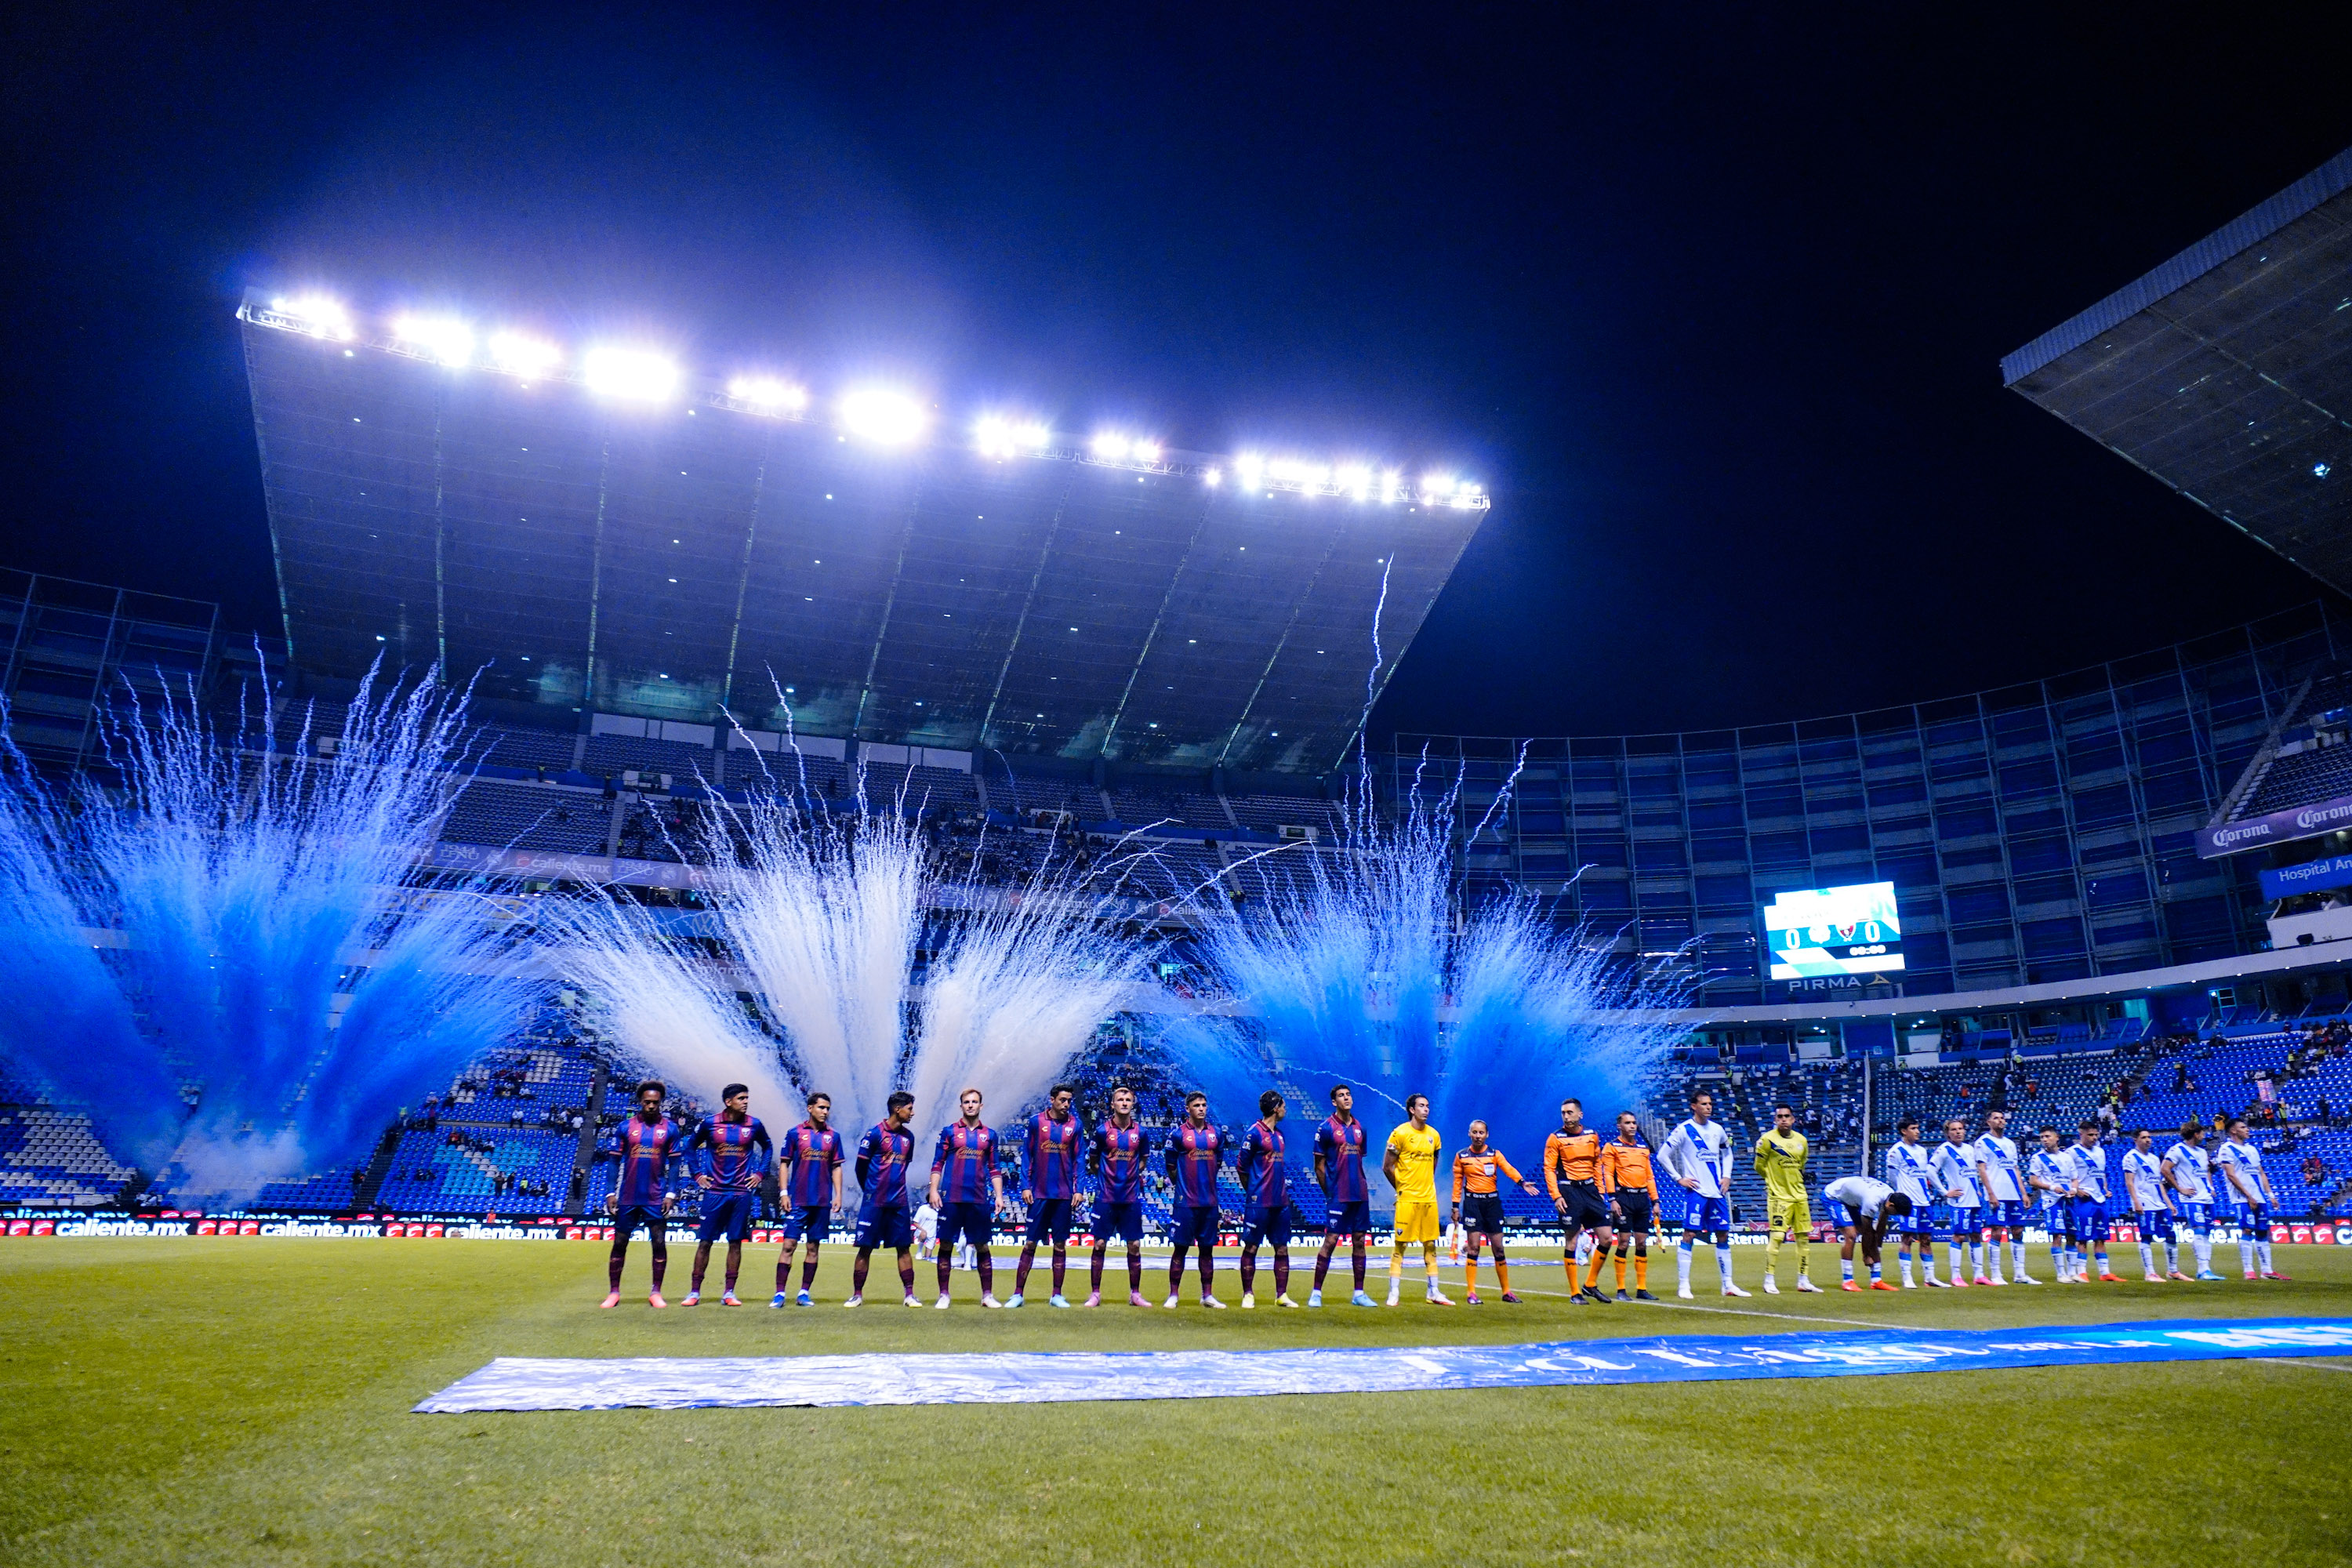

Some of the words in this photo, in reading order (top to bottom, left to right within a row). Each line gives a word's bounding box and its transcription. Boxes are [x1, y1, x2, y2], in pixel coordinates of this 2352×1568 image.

[2212, 824, 2270, 847] Corona
[2278, 861, 2331, 881] Hospital
[1785, 928, 1801, 949] 0
[1864, 921, 1880, 942] 0
[1788, 976, 1862, 992] PIRMA
[56, 1218, 190, 1236] caliente.mx
[260, 1220, 382, 1238] caliente.mx
[445, 1223, 559, 1240] caliente.mx
[1502, 1233, 1566, 1247] caliente.m
[1727, 1232, 1769, 1245] Steren
